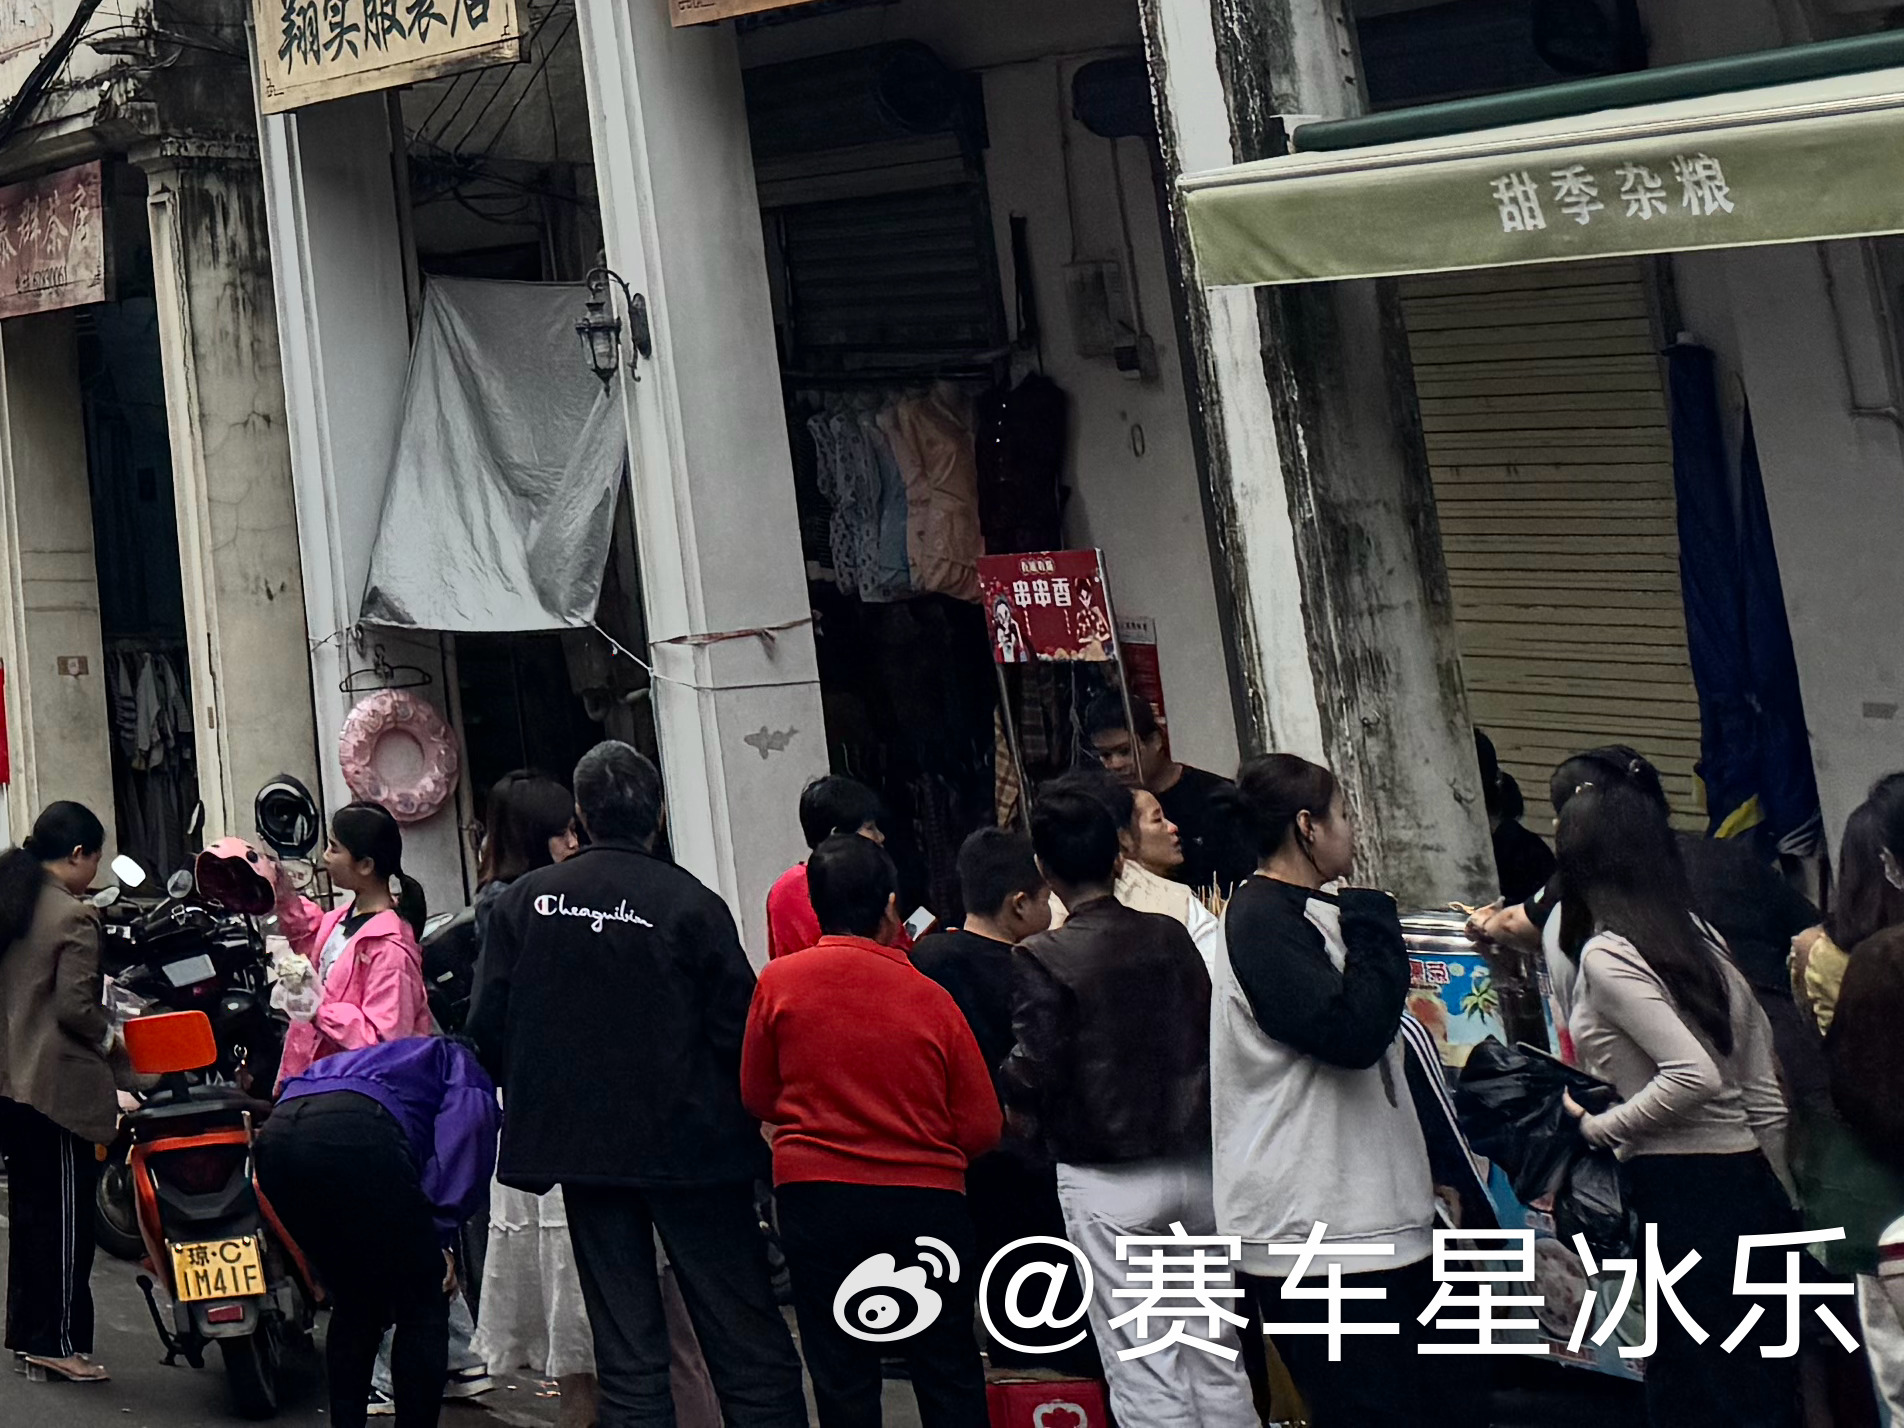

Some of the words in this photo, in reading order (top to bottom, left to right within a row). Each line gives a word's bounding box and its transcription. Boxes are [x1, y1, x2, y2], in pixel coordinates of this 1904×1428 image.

[1491, 153, 1735, 233] 甜季杂粮
[1012, 577, 1072, 608] 串串香
[184, 1264, 257, 1297] 1M41F
